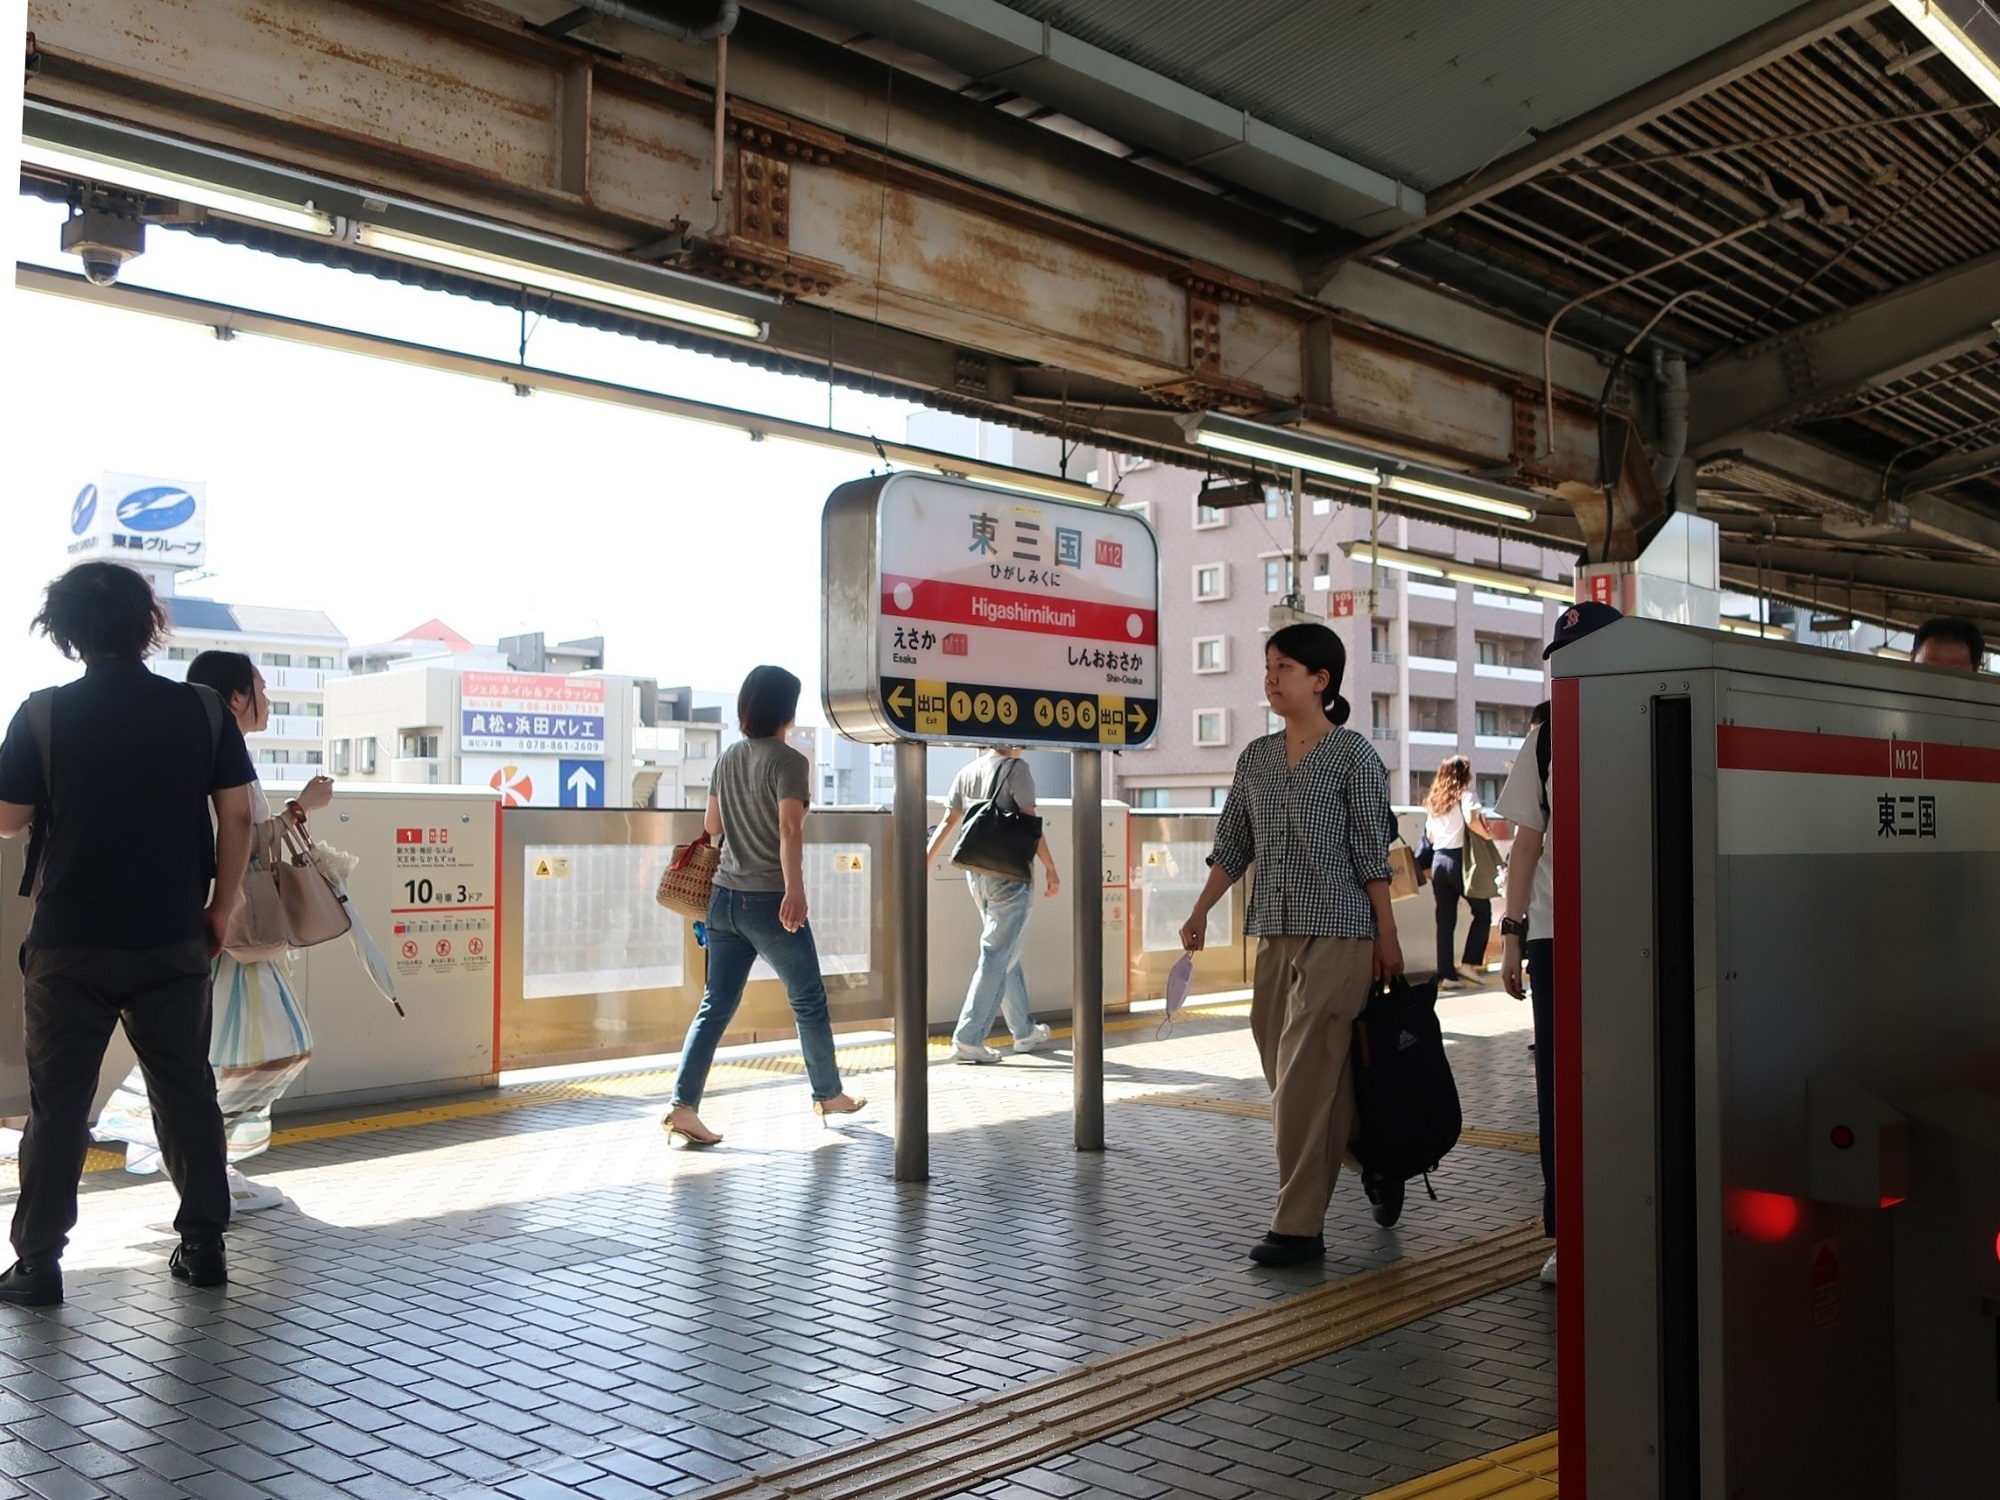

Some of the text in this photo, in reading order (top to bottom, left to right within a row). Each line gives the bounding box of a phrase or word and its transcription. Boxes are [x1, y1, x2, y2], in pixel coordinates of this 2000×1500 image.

[968, 512, 1121, 569] 東三国 M12
[990, 564, 1061, 587] ひがしみくに
[1335, 592, 1352, 600] SOS
[971, 597, 1076, 628] Higashimikuni
[894, 626, 936, 650] えさか
[893, 653, 917, 665] Esaka
[1068, 646, 1143, 671] しんおおさか
[1106, 674, 1143, 685] Shin-Osaka
[917, 694, 1124, 725] 出口 1 2 3 4 5 6 出口
[925, 716, 937, 725] Exit
[1895, 749, 1918, 770] M12
[1877, 793, 1936, 838] 東三国
